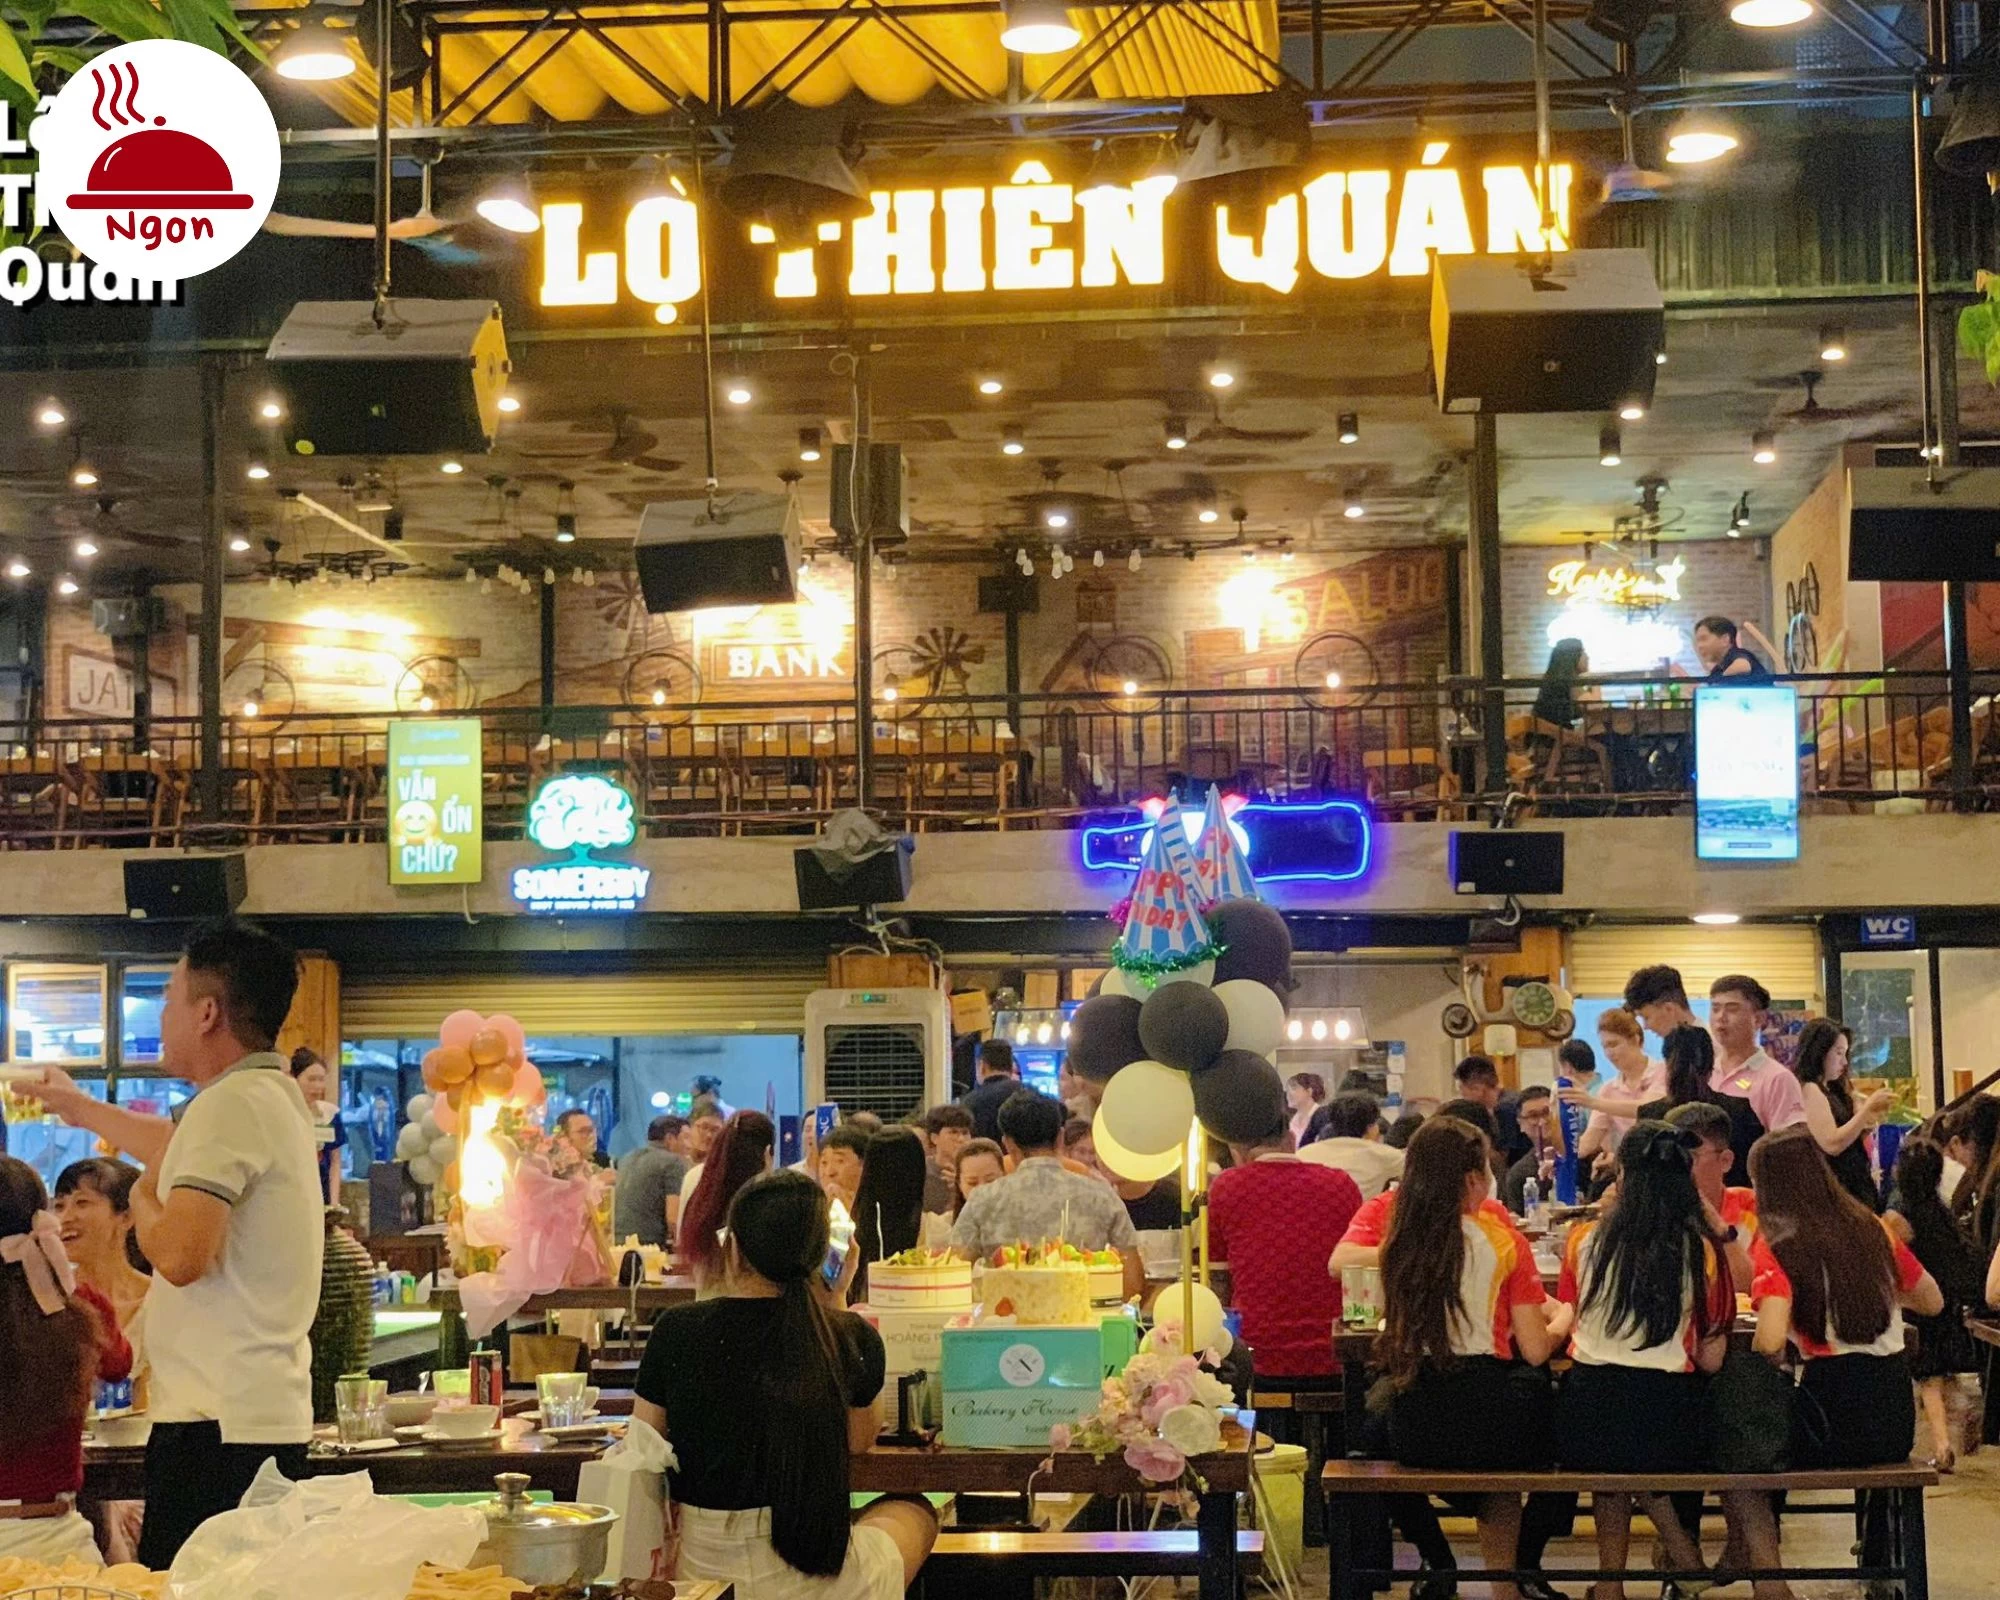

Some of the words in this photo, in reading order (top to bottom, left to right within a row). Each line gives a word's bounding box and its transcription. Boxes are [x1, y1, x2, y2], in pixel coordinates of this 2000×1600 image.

[728, 644, 846, 678] BANK
[1865, 918, 1910, 933] WC
[951, 1399, 1017, 1421] Bakery
